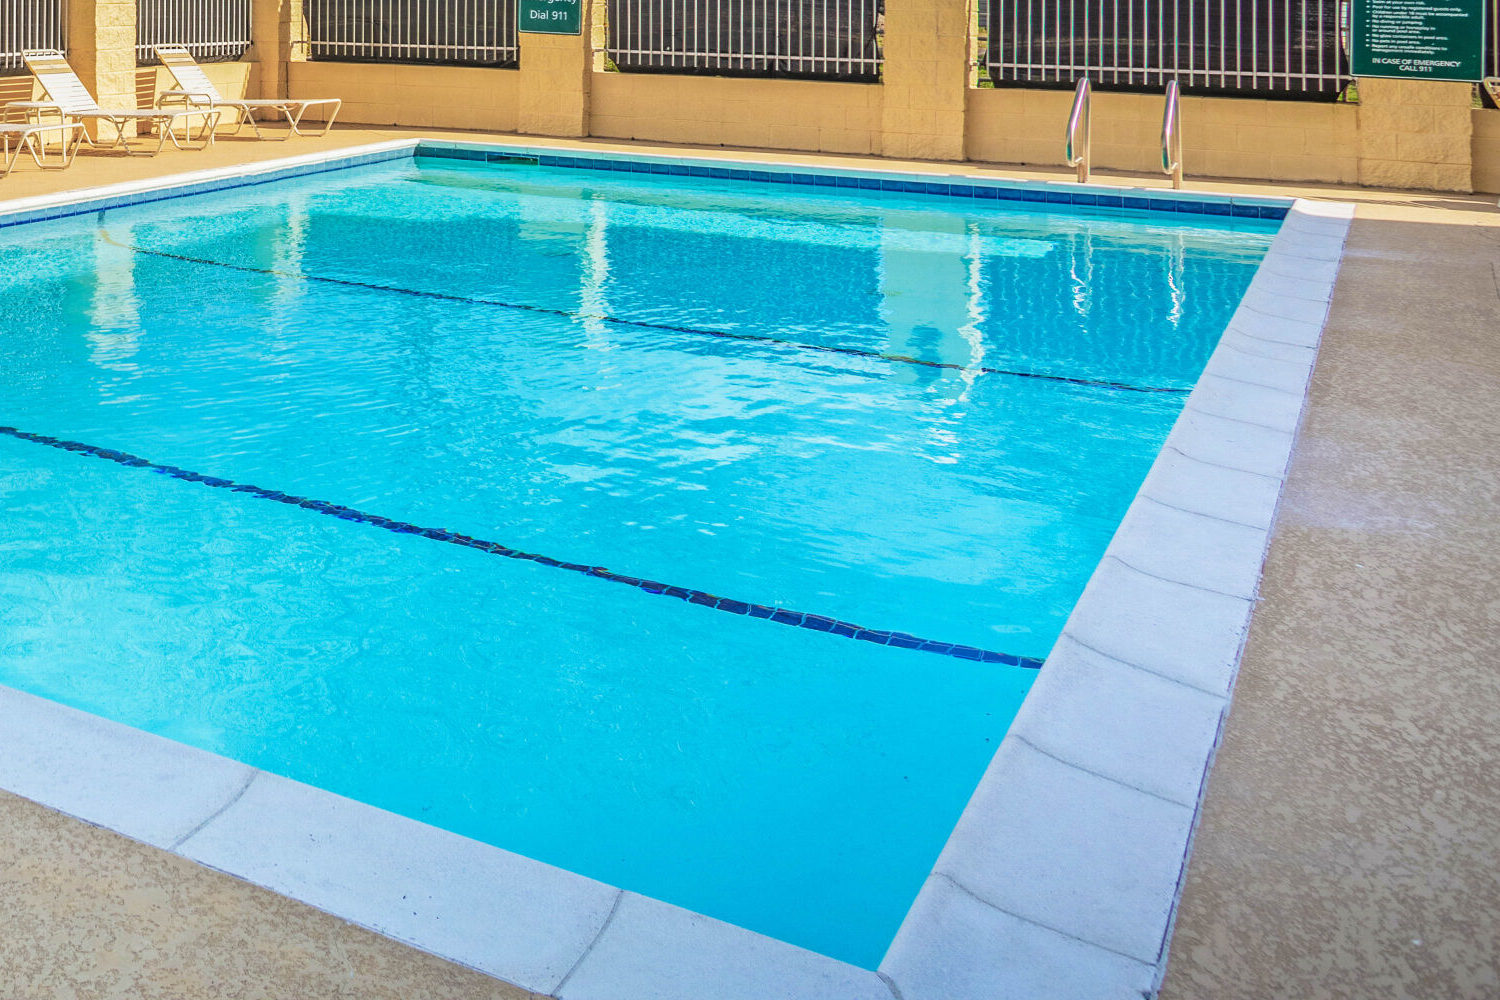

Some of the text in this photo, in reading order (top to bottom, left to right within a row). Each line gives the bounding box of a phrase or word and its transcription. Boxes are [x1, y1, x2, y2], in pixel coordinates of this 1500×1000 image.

[530, 10, 567, 20] Dial 911
[1413, 59, 1461, 68] EMERGENCY
